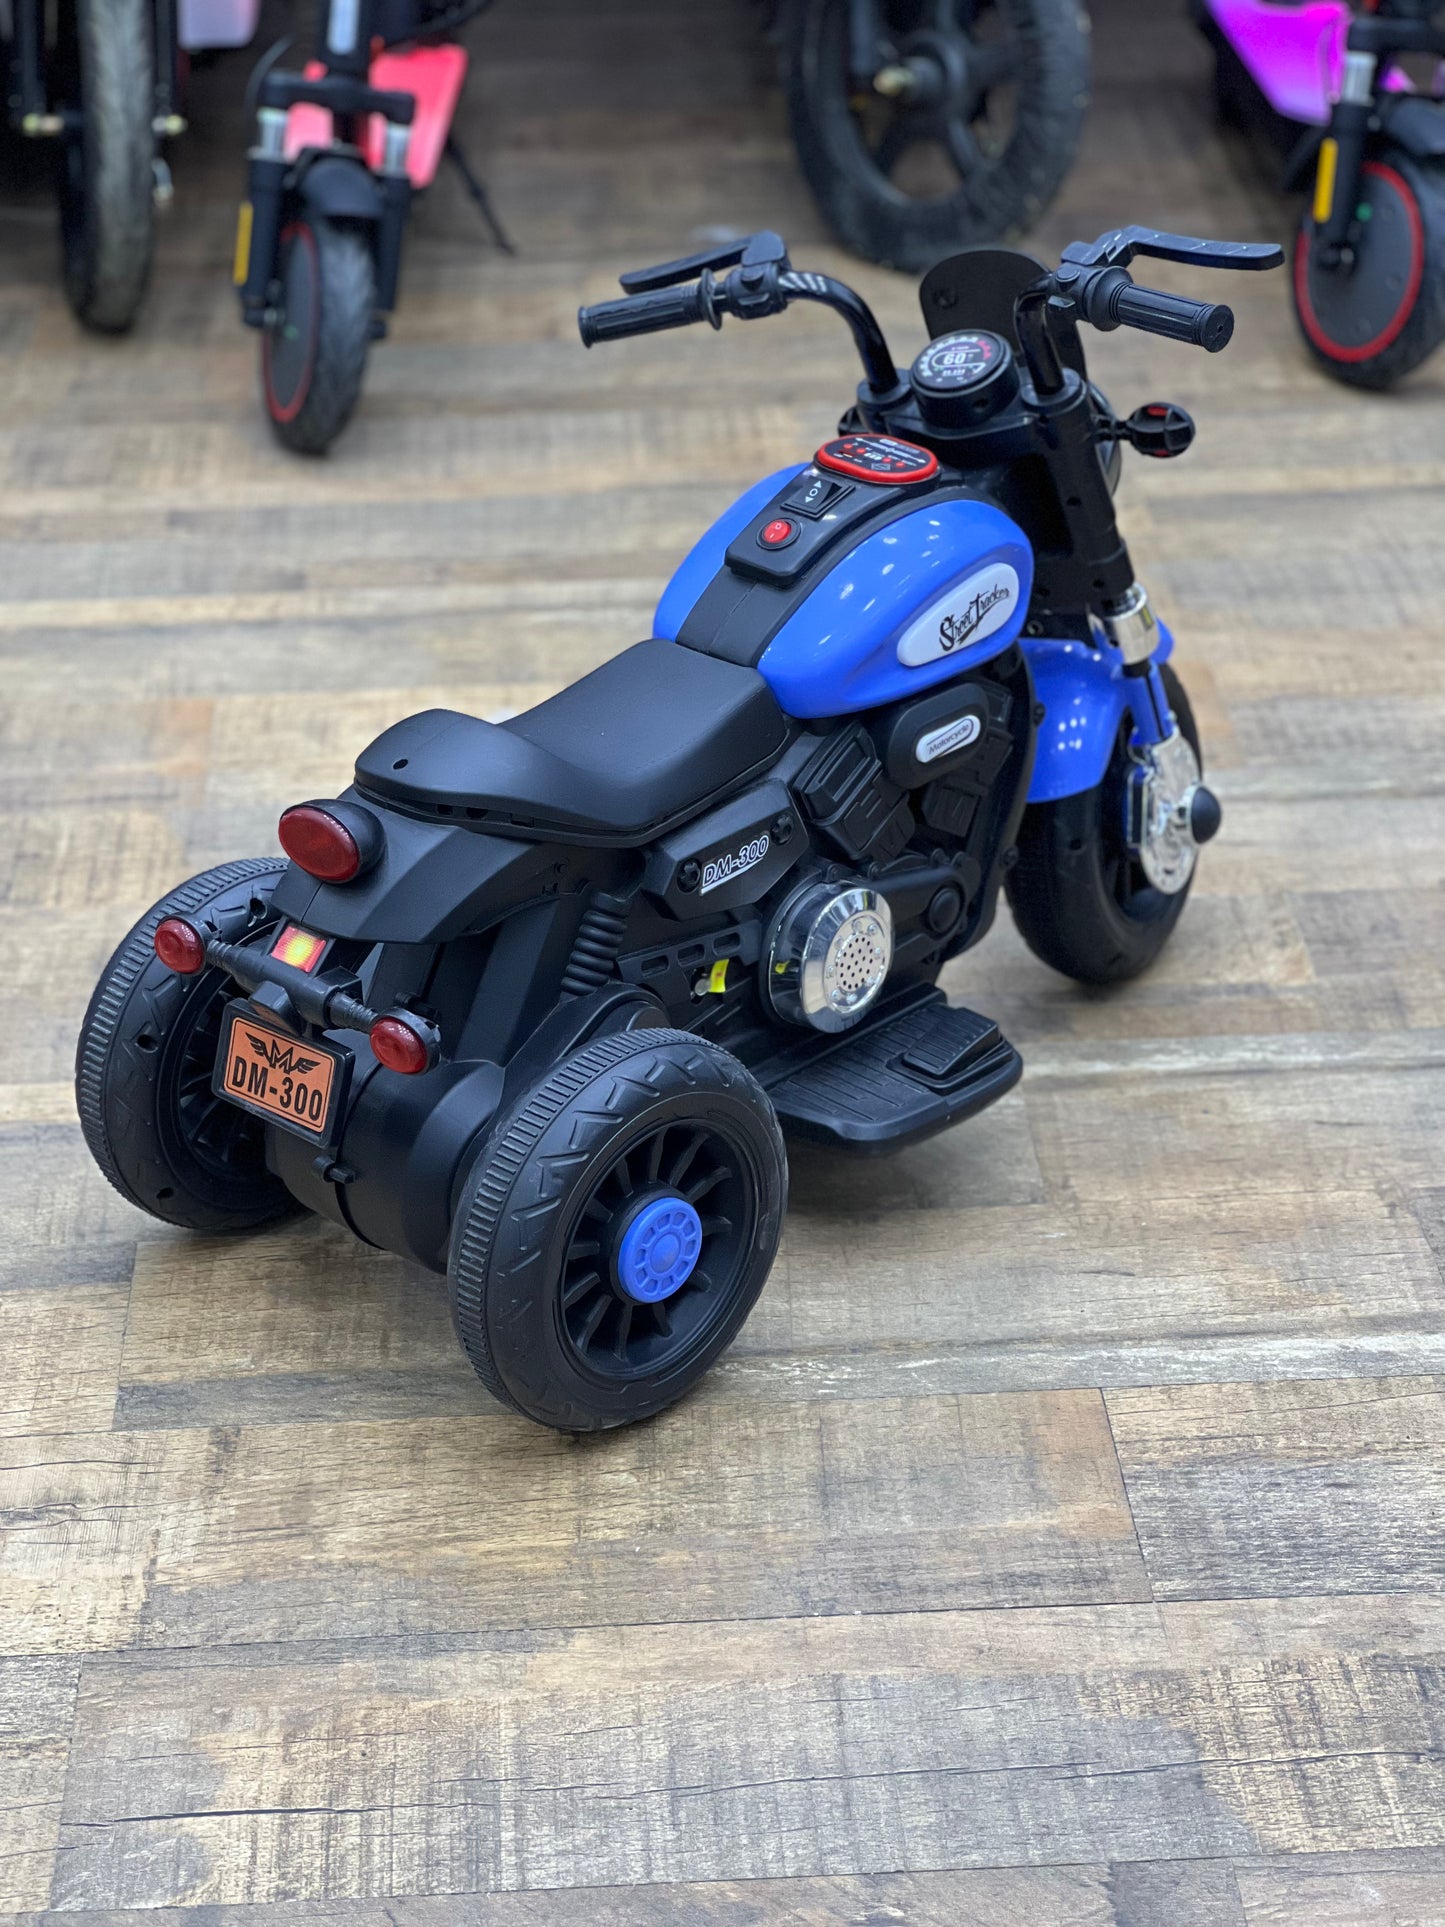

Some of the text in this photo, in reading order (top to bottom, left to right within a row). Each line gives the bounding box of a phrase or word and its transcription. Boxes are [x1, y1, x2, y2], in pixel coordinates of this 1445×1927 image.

[943, 352, 966, 365] 60
[939, 605, 974, 652] Street
[928, 724, 970, 756] Motorcycle
[702, 835, 769, 888] DM-300
[231, 1055, 323, 1121] DM-300
